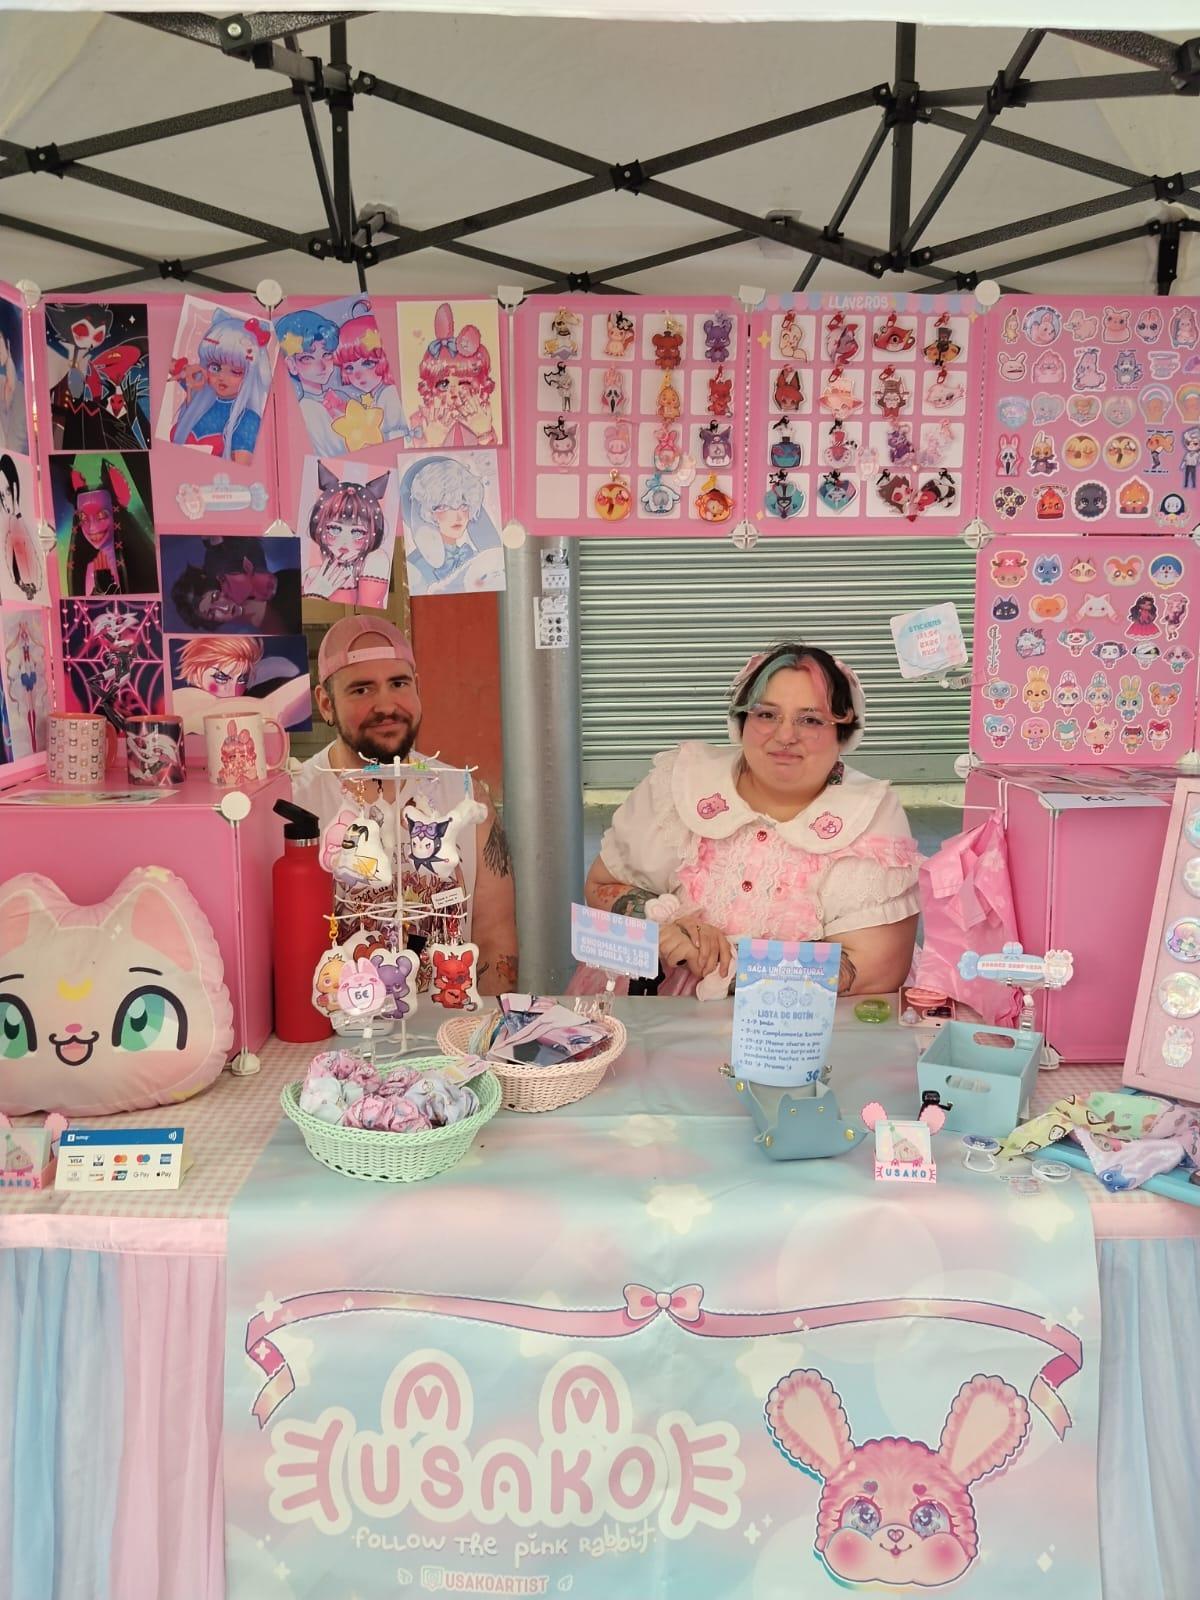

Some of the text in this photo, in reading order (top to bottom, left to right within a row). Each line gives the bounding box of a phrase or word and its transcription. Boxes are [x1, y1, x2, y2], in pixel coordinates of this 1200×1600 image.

[828, 295, 889, 309] LLAVEROS
[757, 1010, 778, 1019] LISTA
[793, 1010, 814, 1020] BOTÍN
[885, 1168, 927, 1178] USAKO
[360, 1442, 656, 1515] USAKO
[444, 1571, 549, 1593] USAKOARTIST
